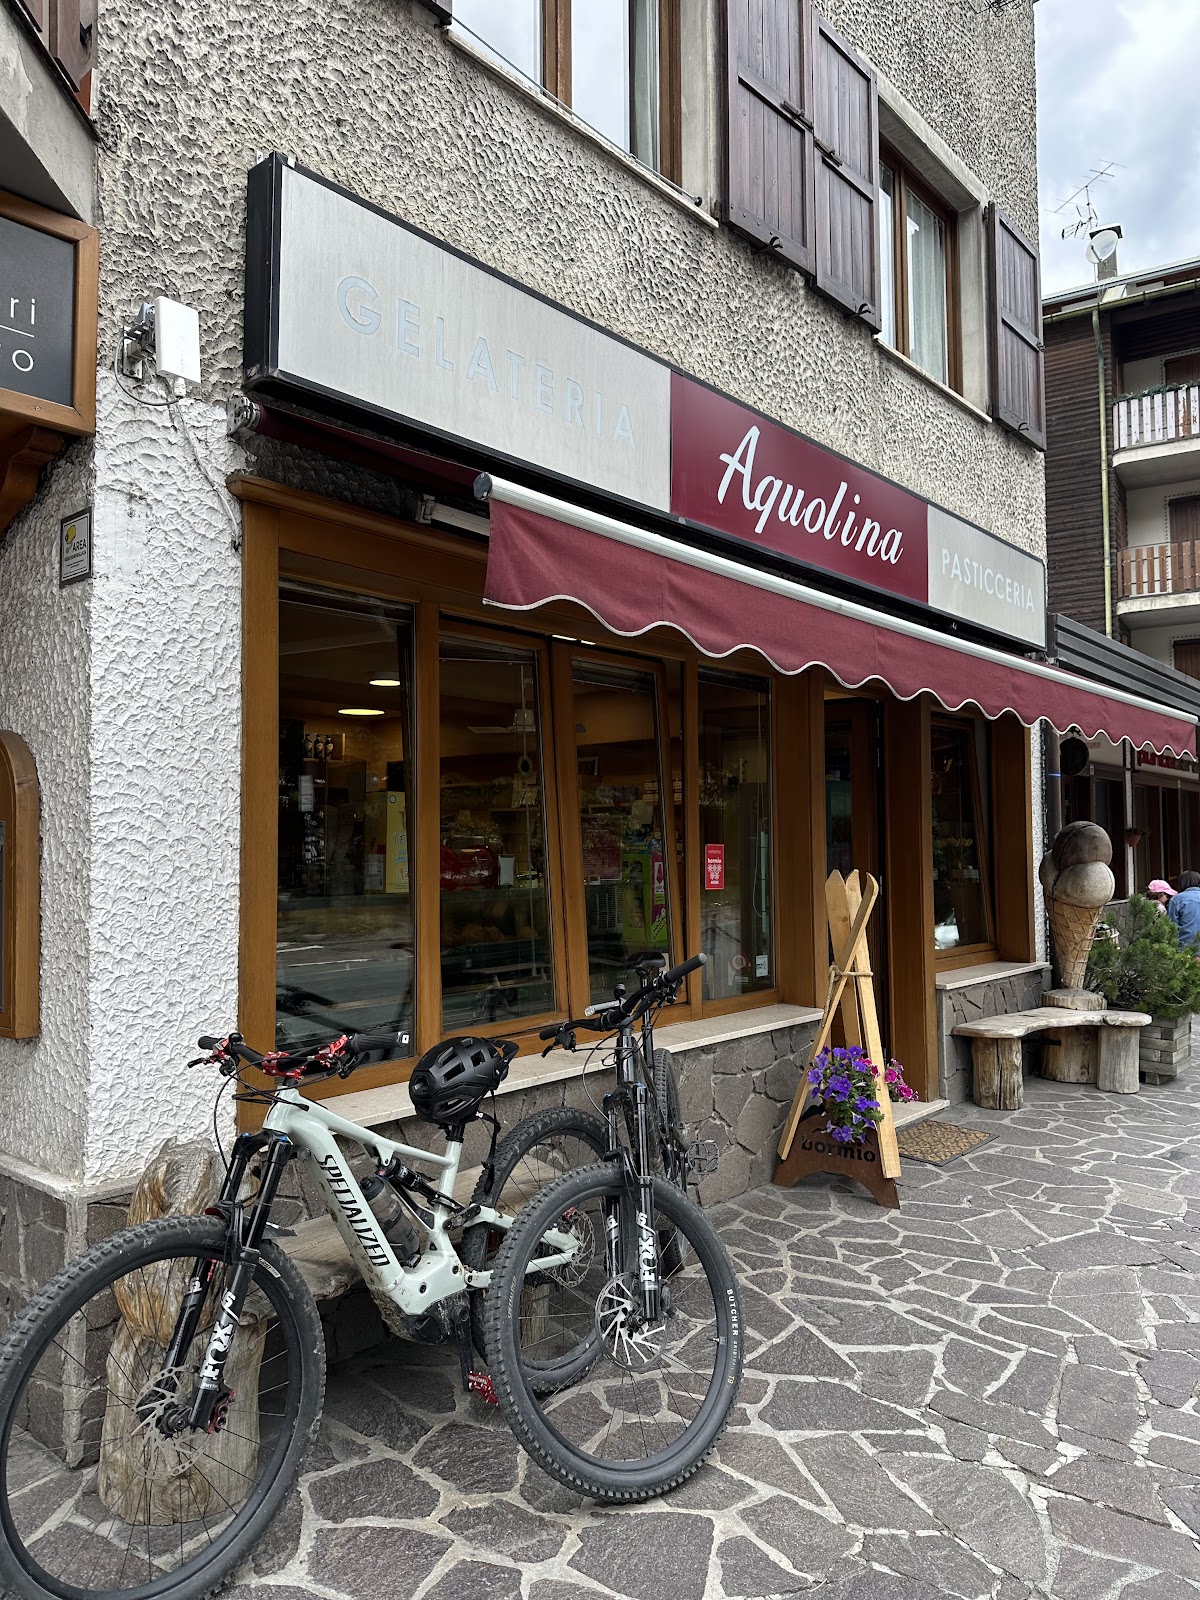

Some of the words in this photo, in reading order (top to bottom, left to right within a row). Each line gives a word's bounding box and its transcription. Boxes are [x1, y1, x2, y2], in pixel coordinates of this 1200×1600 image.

[337, 275, 637, 451] GELATERIA
[717, 425, 904, 565] Aquolina
[73, 538, 87, 552] AREA
[942, 547, 1035, 612] PASTICCERIA
[313, 1154, 390, 1266] SPECIALIZED
[639, 1236, 658, 1282] FOX
[726, 1288, 739, 1336] BUTCHER
[200, 1321, 235, 1381] FOX
